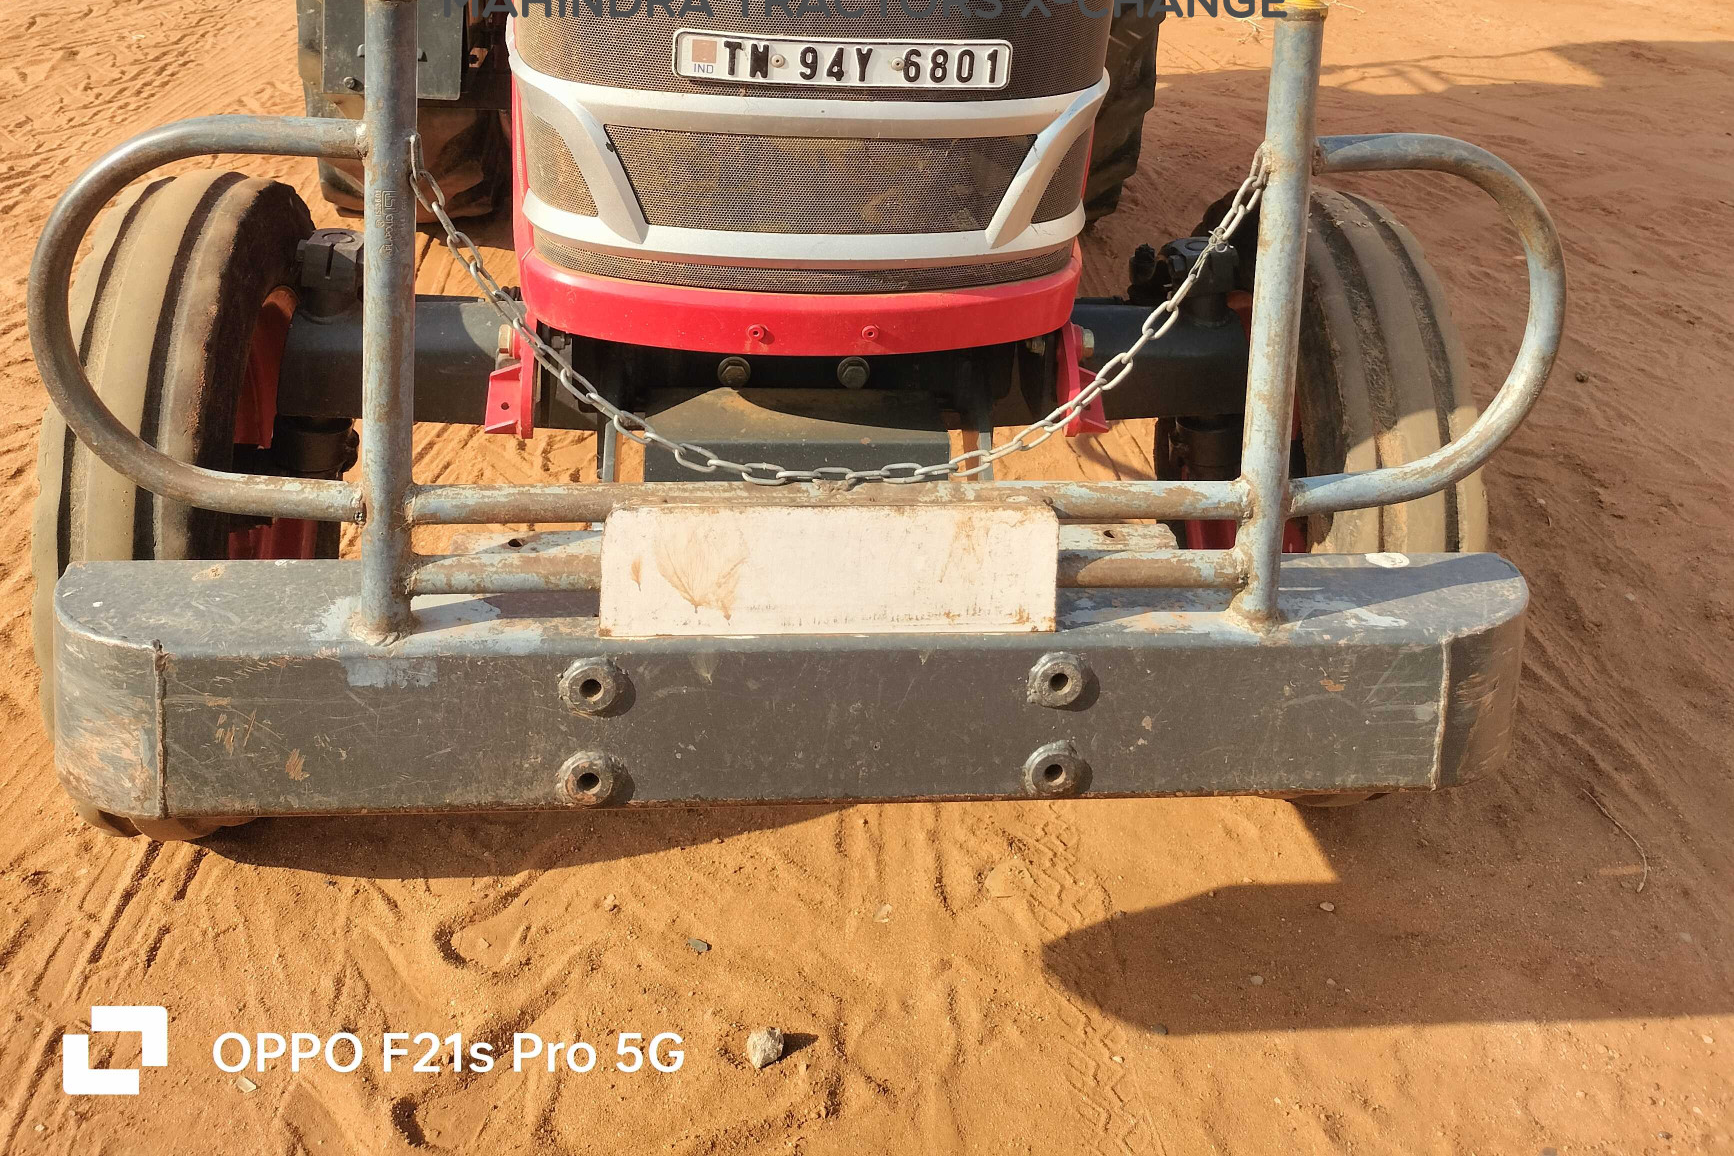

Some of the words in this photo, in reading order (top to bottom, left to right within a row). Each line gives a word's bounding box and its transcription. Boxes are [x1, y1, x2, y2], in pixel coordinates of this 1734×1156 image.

[693, 63, 714, 74] IND
[724, 40, 770, 79] TN
[800, 46, 873, 82] 94Y
[902, 48, 999, 84] 6801
